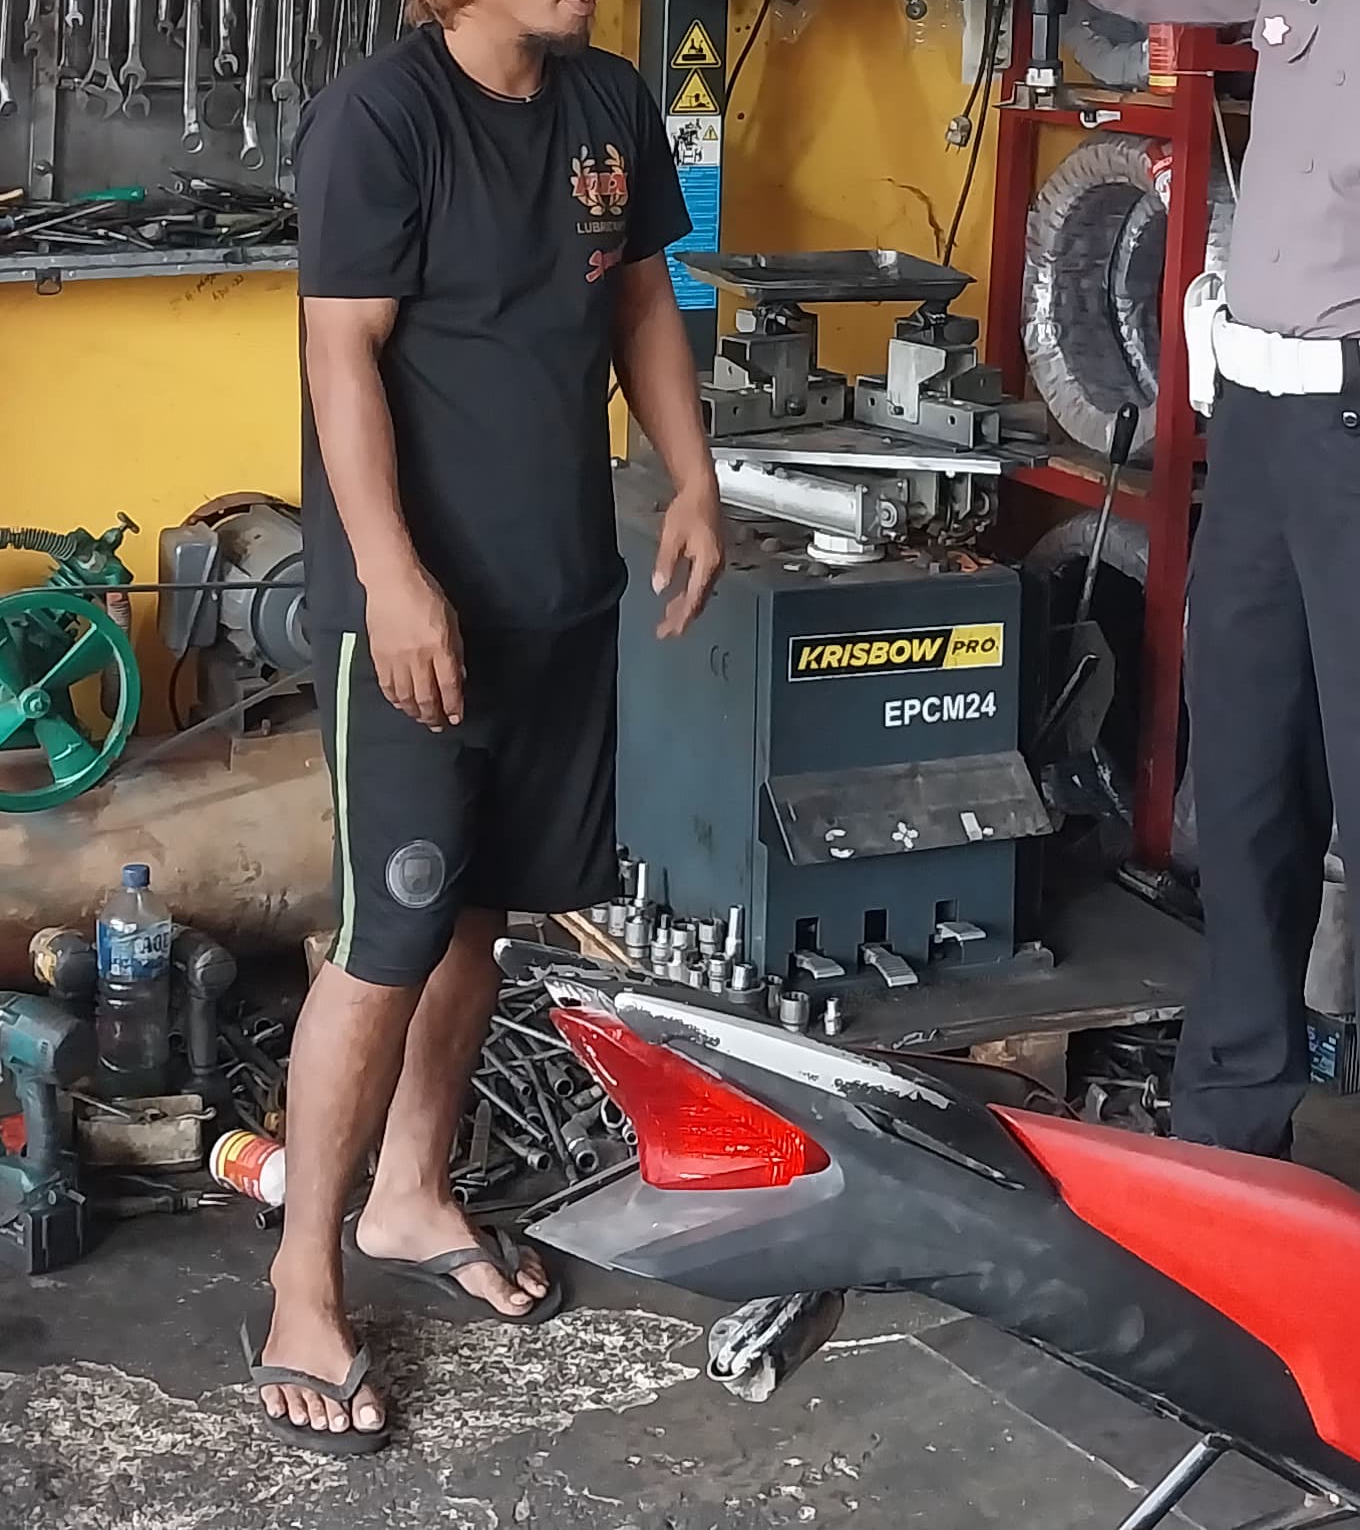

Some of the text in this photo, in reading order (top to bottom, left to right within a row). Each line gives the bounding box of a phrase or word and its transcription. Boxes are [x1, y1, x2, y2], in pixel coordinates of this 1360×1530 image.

[798, 636, 996, 671] KRISBOW PRO
[884, 692, 997, 727] EPCM24
